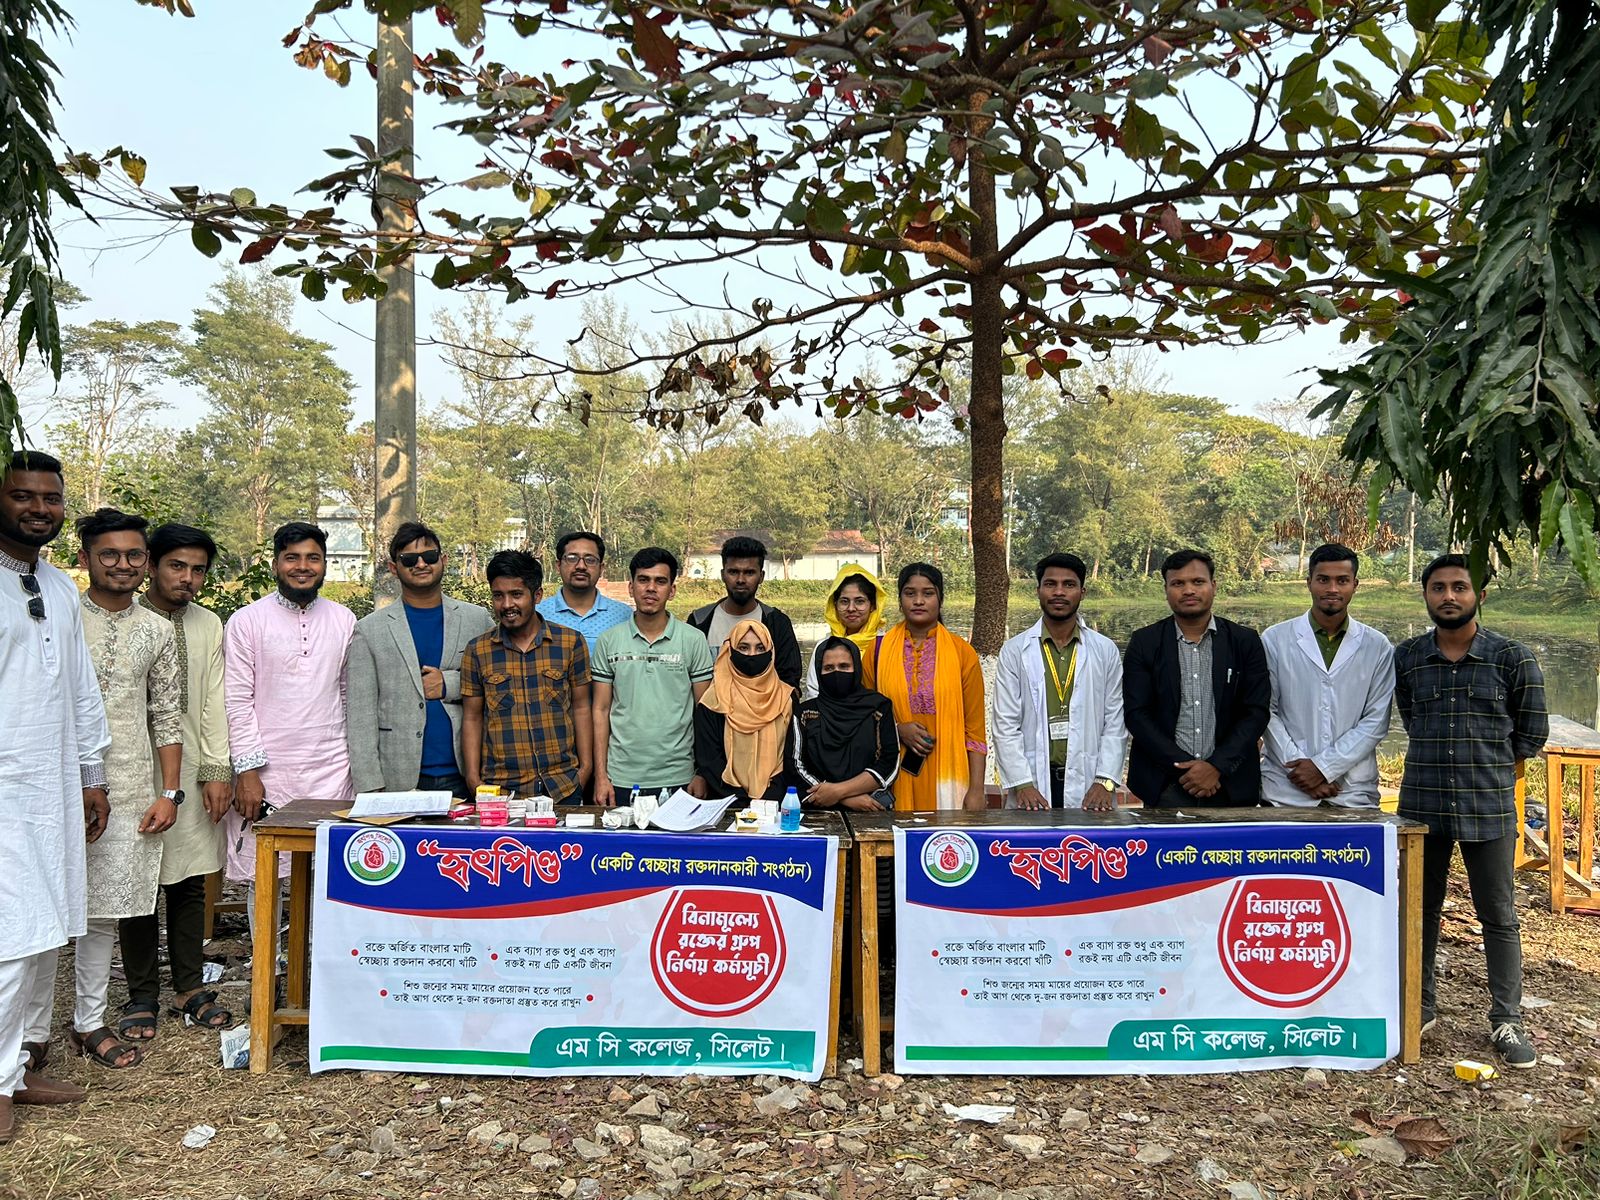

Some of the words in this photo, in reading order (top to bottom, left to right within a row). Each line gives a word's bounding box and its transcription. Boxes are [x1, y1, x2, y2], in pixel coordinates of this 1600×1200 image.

[1156, 846, 1198, 869] (একটি
[1202, 849, 1243, 865] স্বেচ্ছায়
[1247, 844, 1318, 865] রক্তদানকারী
[1321, 843, 1370, 867] সংগঠন)
[591, 852, 635, 875] (একটি
[639, 857, 682, 875] স্বেচ্ছায়
[685, 856, 759, 877] রক্তদানকারী
[762, 857, 812, 882] সংগঠন)
[1246, 891, 1322, 920] বিনামূল্যে
[682, 902, 759, 932] বিনামূল্যে
[1243, 922, 1292, 939] রক্তের
[1295, 922, 1324, 938] গ্রুপ
[365, 943, 385, 952] রক্তে
[388, 941, 417, 952] অর্জিত
[420, 944, 449, 953] বাংলার
[453, 942, 471, 953] মাটি
[678, 933, 727, 950] রক্তের
[730, 935, 761, 951] গ্রুপ
[945, 943, 963, 951] রক্তে
[967, 940, 994, 951] অর্জিত
[997, 943, 1025, 952] বাংলার
[1028, 940, 1046, 952] মাটি
[1096, 941, 1114, 949] ব্যাগ
[1117, 941, 1131, 949] রক্ত
[1134, 941, 1147, 951] শুধু
[1150, 941, 1164, 949] এক
[1167, 941, 1185, 949] ব্যাগ
[506, 946, 521, 954] এক
[524, 946, 542, 955] ব্যাগ
[545, 948, 560, 956] রক্ত
[563, 947, 576, 957] শুধু
[580, 947, 595, 956] এক
[598, 948, 616, 957] ব্যাগ
[1102, 954, 1113, 962] নয়
[1117, 952, 1132, 962] এটি
[1135, 952, 1157, 962] একটি
[1161, 951, 1182, 962] জীবন
[1233, 940, 1275, 964] নির্ণয়
[1279, 939, 1336, 968] কর্মসূচী
[393, 958, 424, 966] রক্তদান
[427, 959, 455, 967] করবো
[529, 960, 541, 969] নয়
[544, 959, 560, 969] এটি
[563, 958, 586, 969] একটি
[590, 958, 612, 970] জীবন
[666, 950, 710, 975] নির্ণয়
[712, 953, 769, 981] কর্মসূচী
[972, 957, 1001, 965] রক্তদান
[1005, 957, 1031, 966] করবো
[403, 980, 420, 990] শিশু
[451, 983, 469, 991] সময়
[472, 983, 495, 992] মায়ের
[498, 985, 530, 994] প্রয়োজন
[533, 986, 549, 994] হতে
[553, 986, 572, 995] পারে
[983, 978, 999, 988] শিশু
[1028, 981, 1045, 989] সময়
[1048, 980, 1070, 988] মায়ের
[1074, 980, 1104, 988] প্রয়োজন
[1108, 980, 1123, 988] হতে
[1127, 980, 1144, 988] পারে
[393, 993, 408, 1002] তাই
[412, 994, 429, 1003] আগ
[432, 995, 453, 1003] থেকে
[483, 996, 514, 1005] রক্তদাতা
[541, 998, 558, 1007] করে
[561, 998, 581, 1007] রাখুন
[973, 991, 988, 1000] তাই
[992, 992, 1008, 1000] আগ
[1060, 992, 1091, 1001] রক্তদাতা
[1117, 992, 1132, 1000] করে
[1136, 992, 1154, 1001] রাখুন
[1133, 1032, 1166, 1051] এম
[1171, 1024, 1196, 1051] সি
[1200, 1031, 1275, 1054] কলেজ,
[556, 1037, 591, 1058] এম
[596, 1032, 622, 1057] সি
[627, 1038, 701, 1061] কলেজ,
